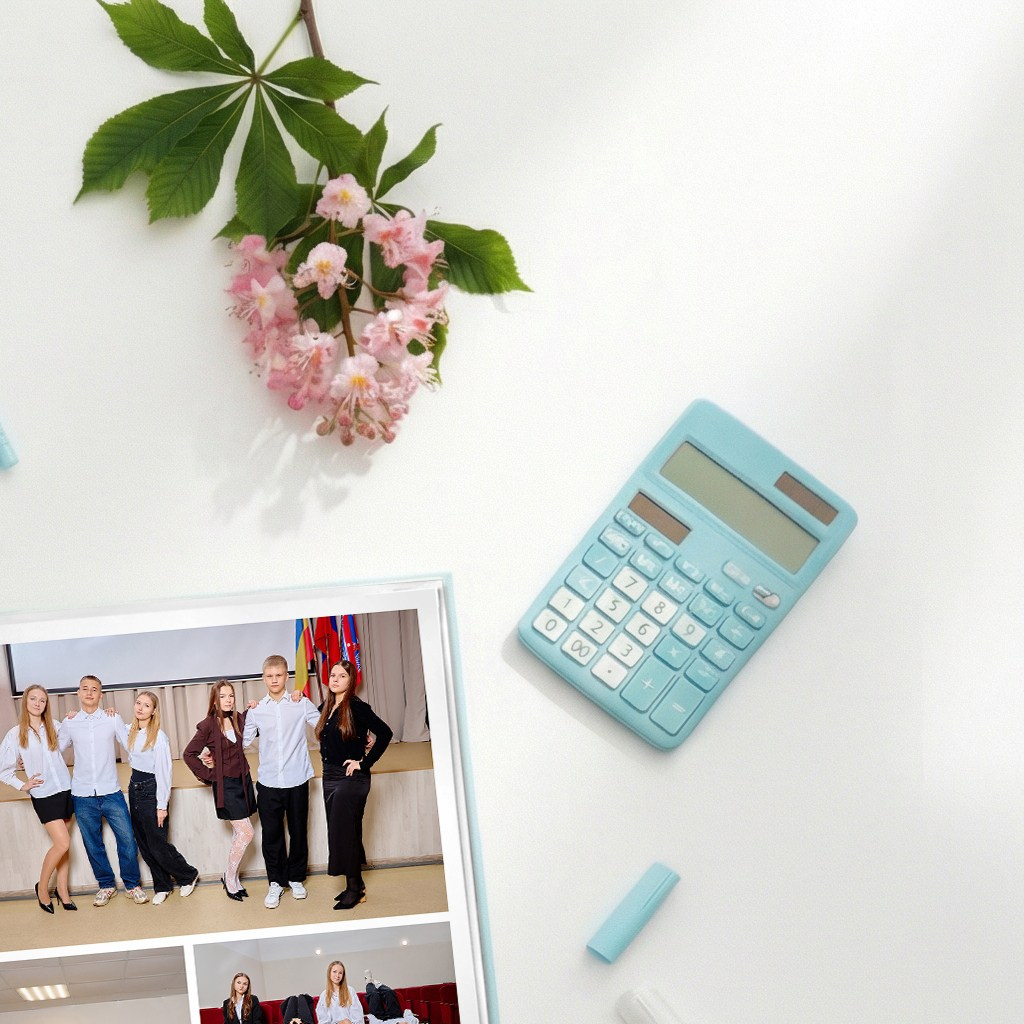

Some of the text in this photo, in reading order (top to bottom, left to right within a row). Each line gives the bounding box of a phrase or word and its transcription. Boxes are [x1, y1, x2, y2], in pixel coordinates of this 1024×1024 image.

[625, 576, 638, 588] 7
[563, 598, 572, 609] 1
[609, 599, 621, 612] 5
[654, 601, 666, 614] 8
[545, 619, 557, 631] 0
[590, 620, 604, 635] 2
[638, 623, 650, 635] 6
[682, 624, 695, 636] 9
[570, 639, 590, 657] 00
[620, 644, 633, 657] 3
